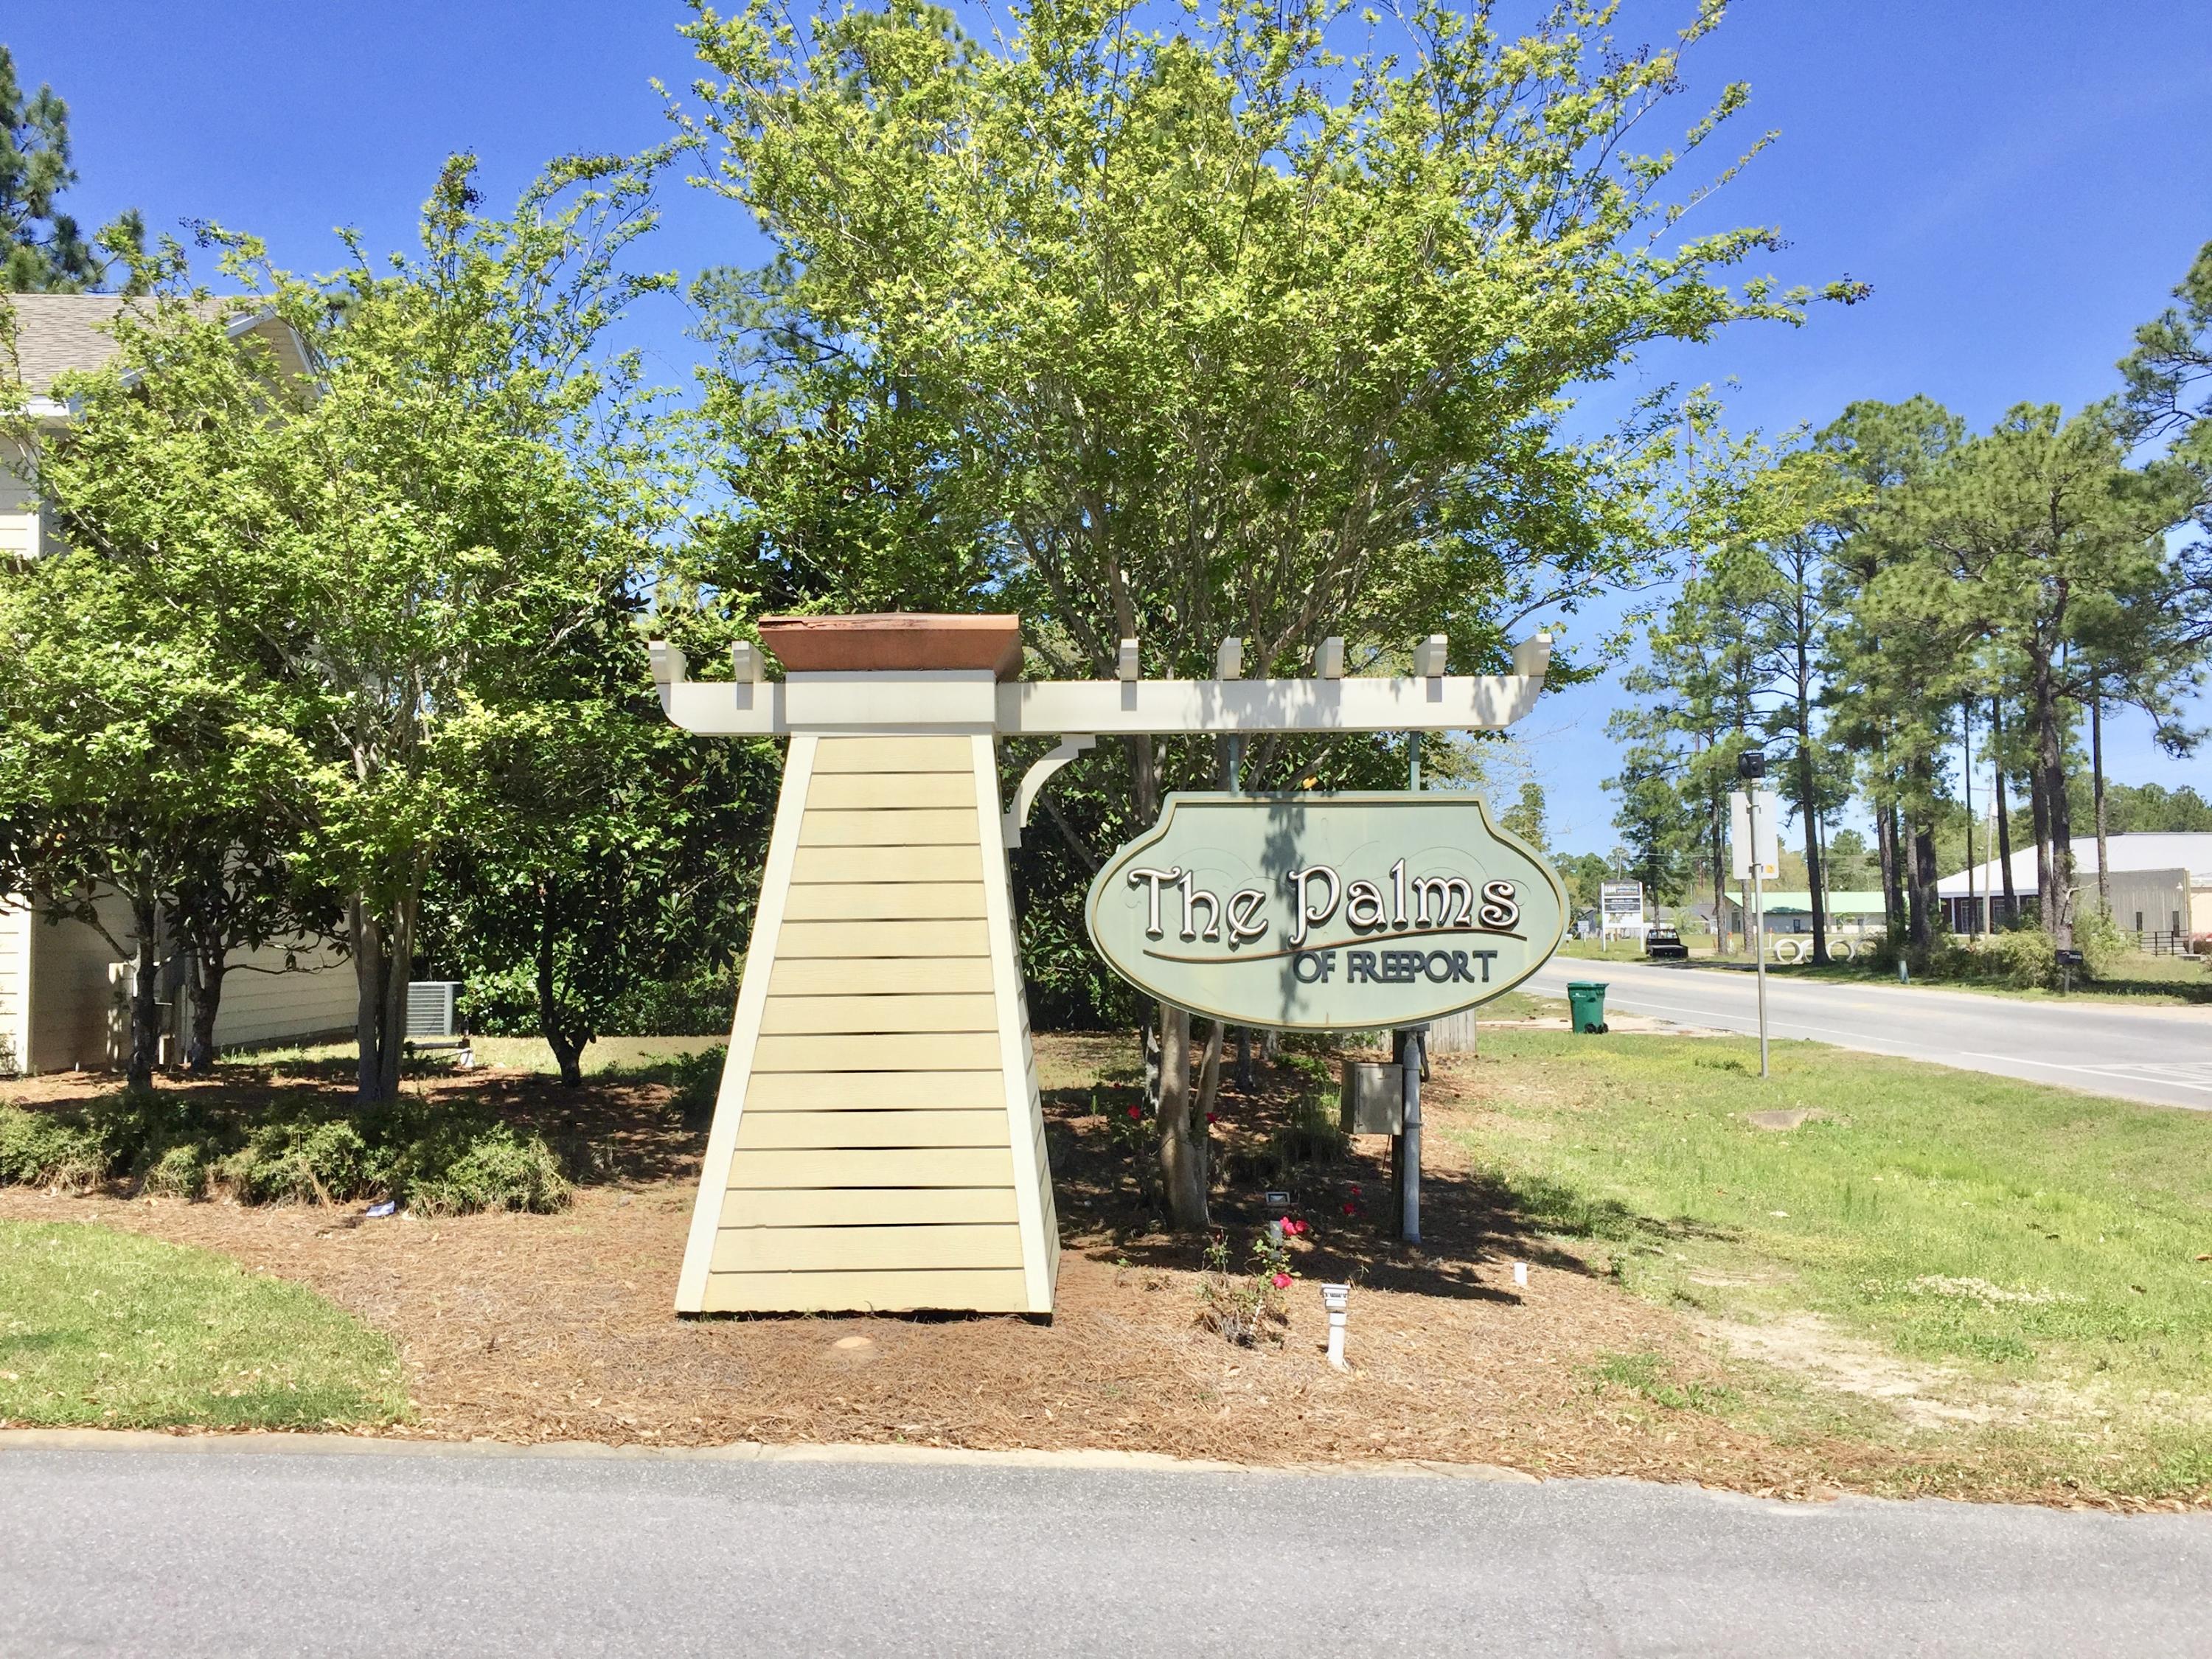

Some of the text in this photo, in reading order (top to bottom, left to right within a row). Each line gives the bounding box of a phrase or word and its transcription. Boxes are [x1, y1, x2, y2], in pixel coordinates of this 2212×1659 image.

[1127, 858, 1520, 950] The Palms
[1294, 950, 1498, 983] OF FREEPORT
